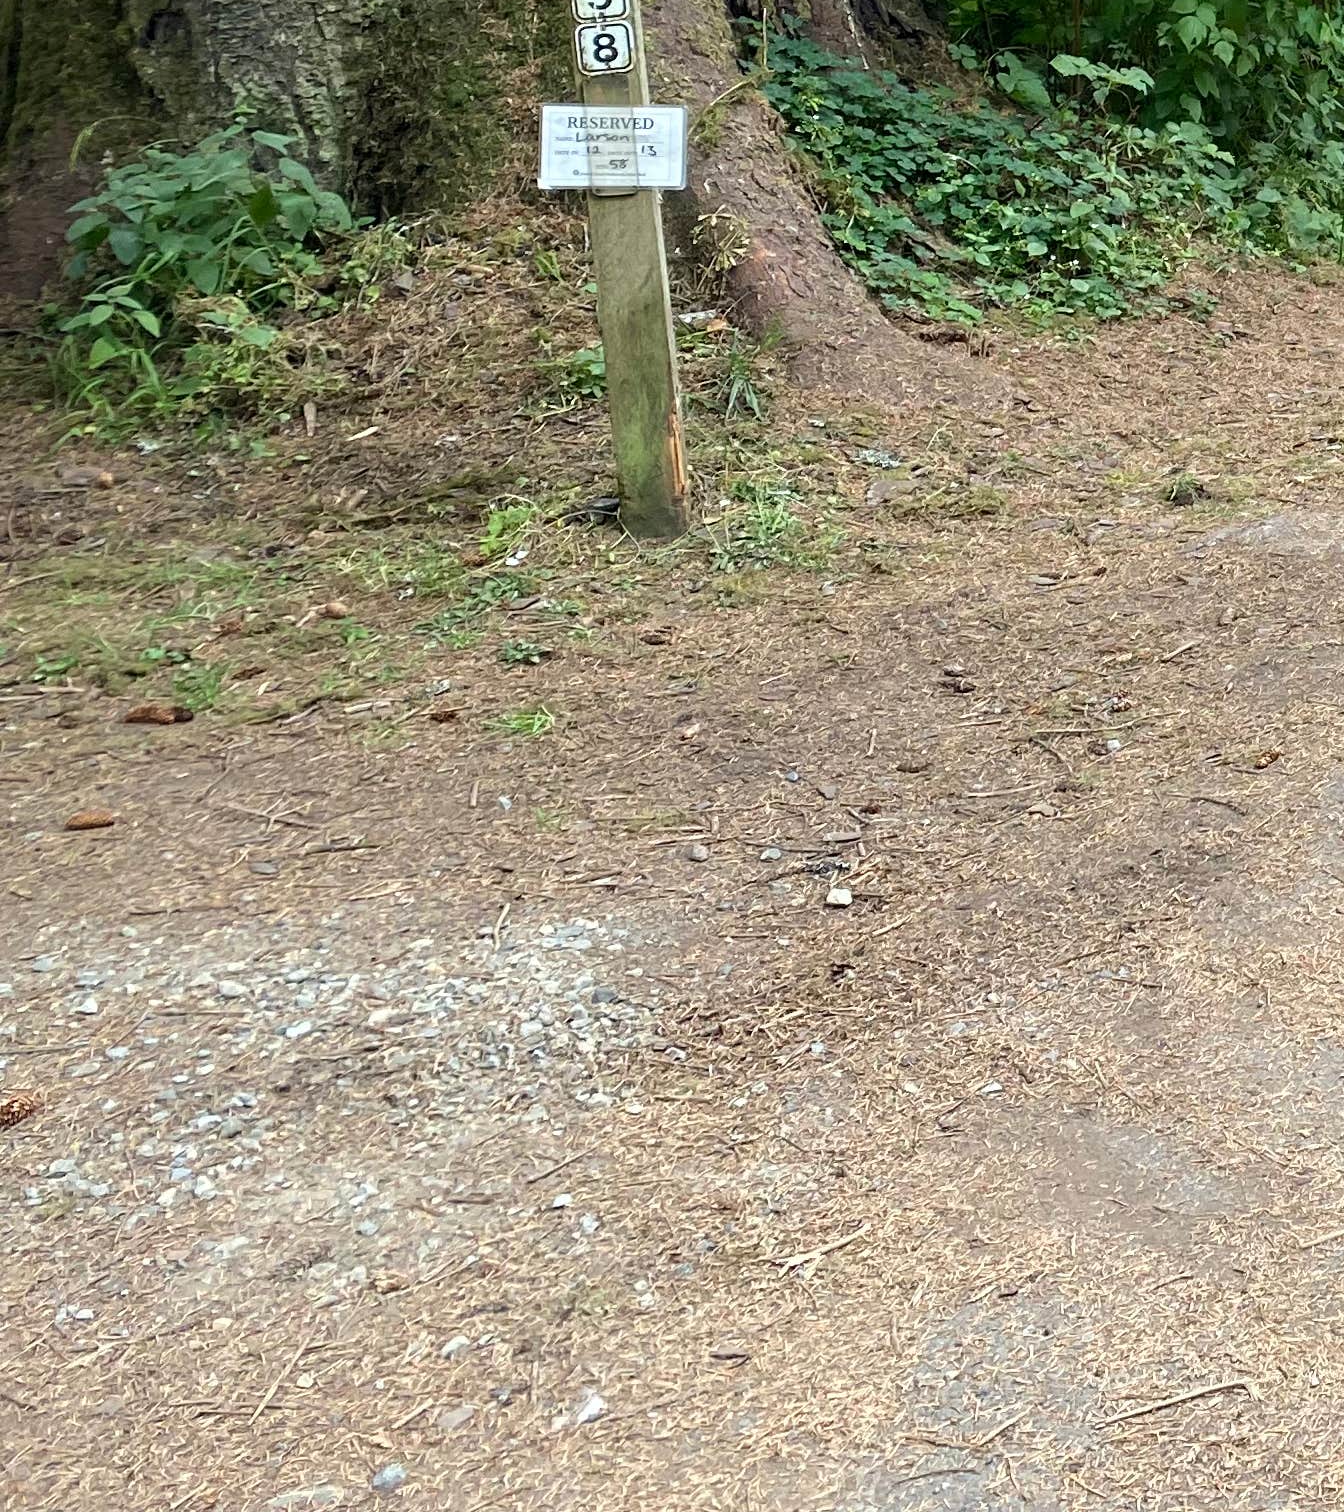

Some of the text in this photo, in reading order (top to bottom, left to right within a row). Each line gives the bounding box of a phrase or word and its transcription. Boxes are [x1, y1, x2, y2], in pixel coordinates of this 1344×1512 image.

[593, 33, 619, 64] 8
[567, 116, 655, 130] RESERVED
[641, 145, 657, 157] 13
